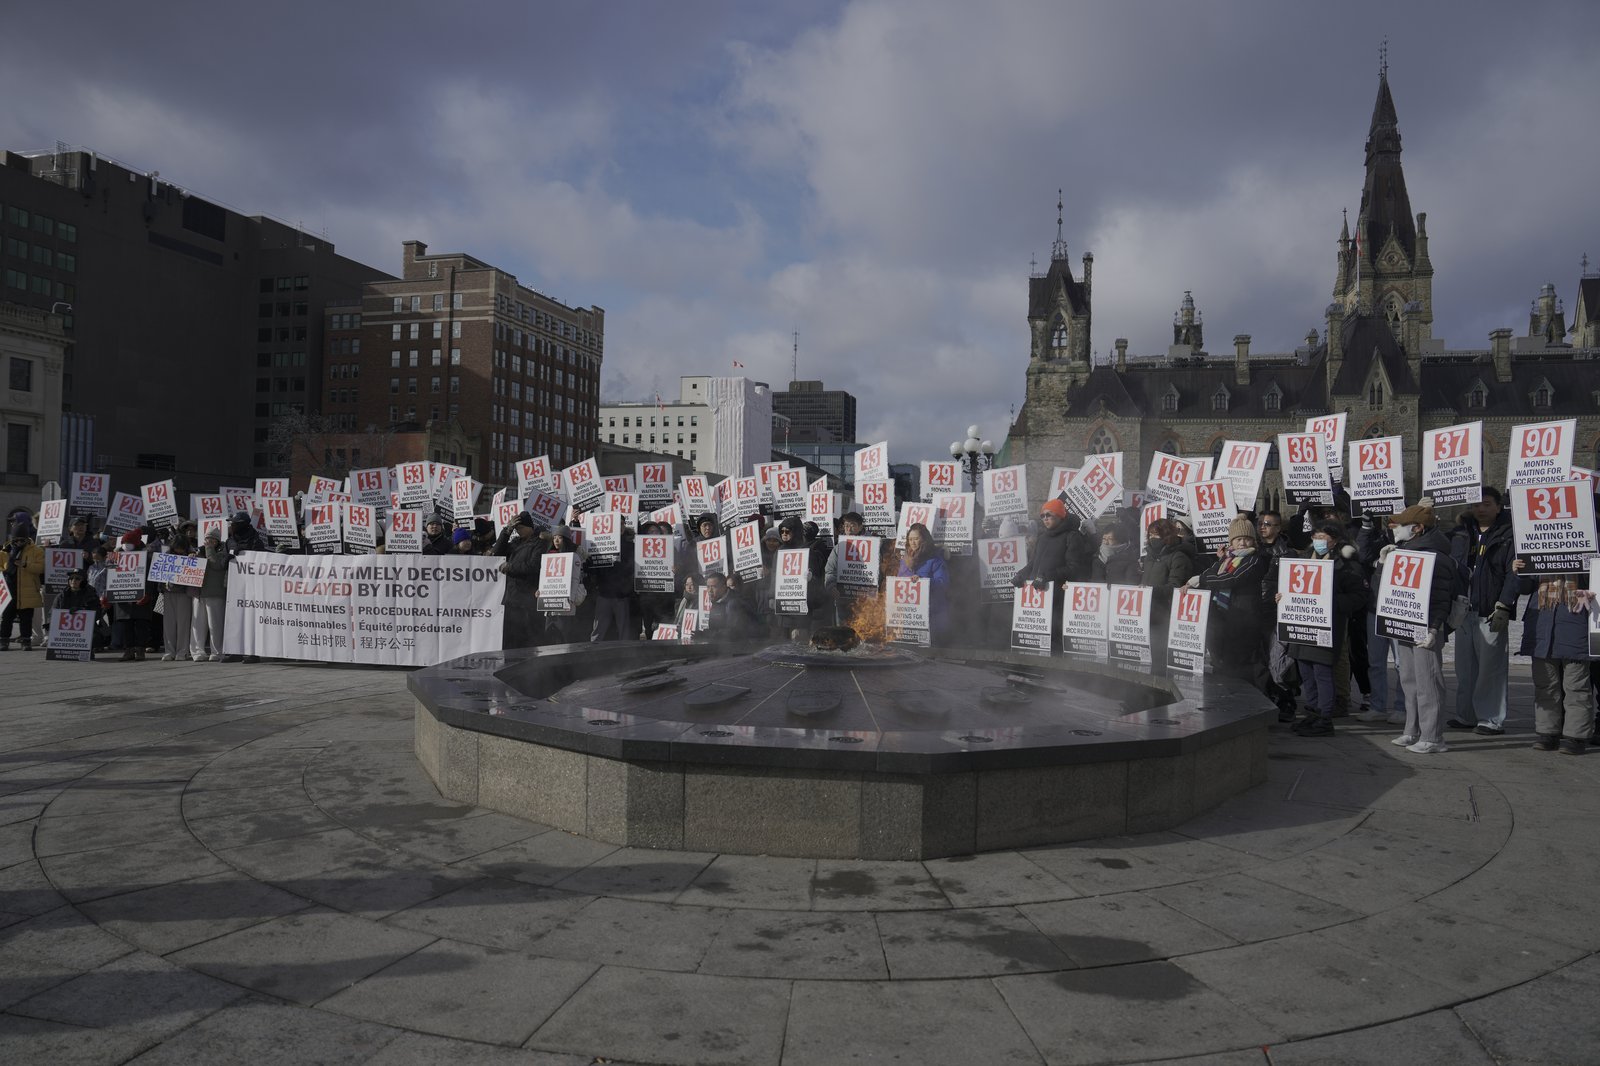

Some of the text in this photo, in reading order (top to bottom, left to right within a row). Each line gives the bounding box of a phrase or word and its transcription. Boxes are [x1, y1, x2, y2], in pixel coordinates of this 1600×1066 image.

[1292, 438, 1316, 462] 36
[1439, 430, 1466, 459] 37
[1526, 428, 1556, 456] 90
[862, 449, 879, 469] 43
[1236, 446, 1256, 469] 70
[1362, 443, 1388, 470] 28
[1438, 460, 1464, 468] MONTHS
[1524, 459, 1554, 467] MONTHS
[405, 466, 423, 484] 53
[526, 460, 542, 480] 25
[572, 465, 591, 486] 33
[645, 466, 664, 482] 27
[931, 465, 952, 484] 29
[1163, 459, 1184, 485] 16
[1431, 468, 1457, 478] WAITING
[1442, 474, 1476, 484] RESPONSE
[80, 476, 101, 491] 54
[263, 482, 280, 497] 42
[361, 472, 381, 490] 15
[687, 480, 702, 496] 33
[739, 480, 755, 498] 28
[780, 472, 798, 491] 38
[994, 471, 1015, 492] 63
[1086, 469, 1113, 496] 35
[1158, 484, 1180, 494] MONTHS
[150, 485, 167, 501] 42
[866, 484, 886, 504] 65
[1152, 489, 1184, 503] WAITING FOR
[1200, 485, 1223, 510] 31
[45, 503, 60, 519] 30
[124, 496, 142, 515] 20
[204, 498, 219, 514] 32
[270, 500, 288, 517] 11
[535, 494, 557, 518] 55
[613, 495, 631, 513] 34
[813, 494, 826, 513] 55
[1534, 488, 1572, 519] 31
[313, 506, 332, 524] 71
[352, 507, 367, 526] 53
[394, 513, 414, 532] 34
[594, 516, 612, 535] 39
[1534, 522, 1572, 531] MONTHS
[738, 527, 753, 548] 24
[1526, 532, 1563, 540] WAITING
[1542, 540, 1590, 549] RESPONSE
[644, 539, 665, 558] 33
[704, 542, 718, 562] 46
[847, 540, 868, 561] 40
[992, 543, 1016, 563] 23
[55, 552, 73, 567] 20
[158, 554, 177, 564] STOP
[550, 558, 565, 576] 41
[784, 554, 800, 574] 34
[237, 562, 498, 582] WE DEMAND A TIMELY DECISION
[1292, 565, 1318, 594] 37
[1394, 556, 1421, 586] 37
[285, 580, 429, 598] DELAYED BY IRCC
[898, 582, 917, 604] 35
[1392, 590, 1415, 598] MONTHS
[237, 600, 345, 614] REASONABLE TIMELINES
[1074, 588, 1099, 612] 36
[1119, 590, 1141, 616] 21
[1178, 595, 1198, 622] 14
[1385, 598, 1408, 607] WAITING
[60, 613, 84, 630] 36
[359, 607, 492, 618] PROCEDURAL FAIRNESS
[1295, 614, 1327, 623] RESPONSE
[1381, 606, 1424, 620] IRCC RESPONSE
[260, 616, 346, 630] Délais raisonnables
[359, 620, 462, 633] Équité procédurale
[298, 633, 346, 647] 给出时限
[361, 636, 415, 651] 程序公平
[1122, 634, 1146, 642] RESPONSE
